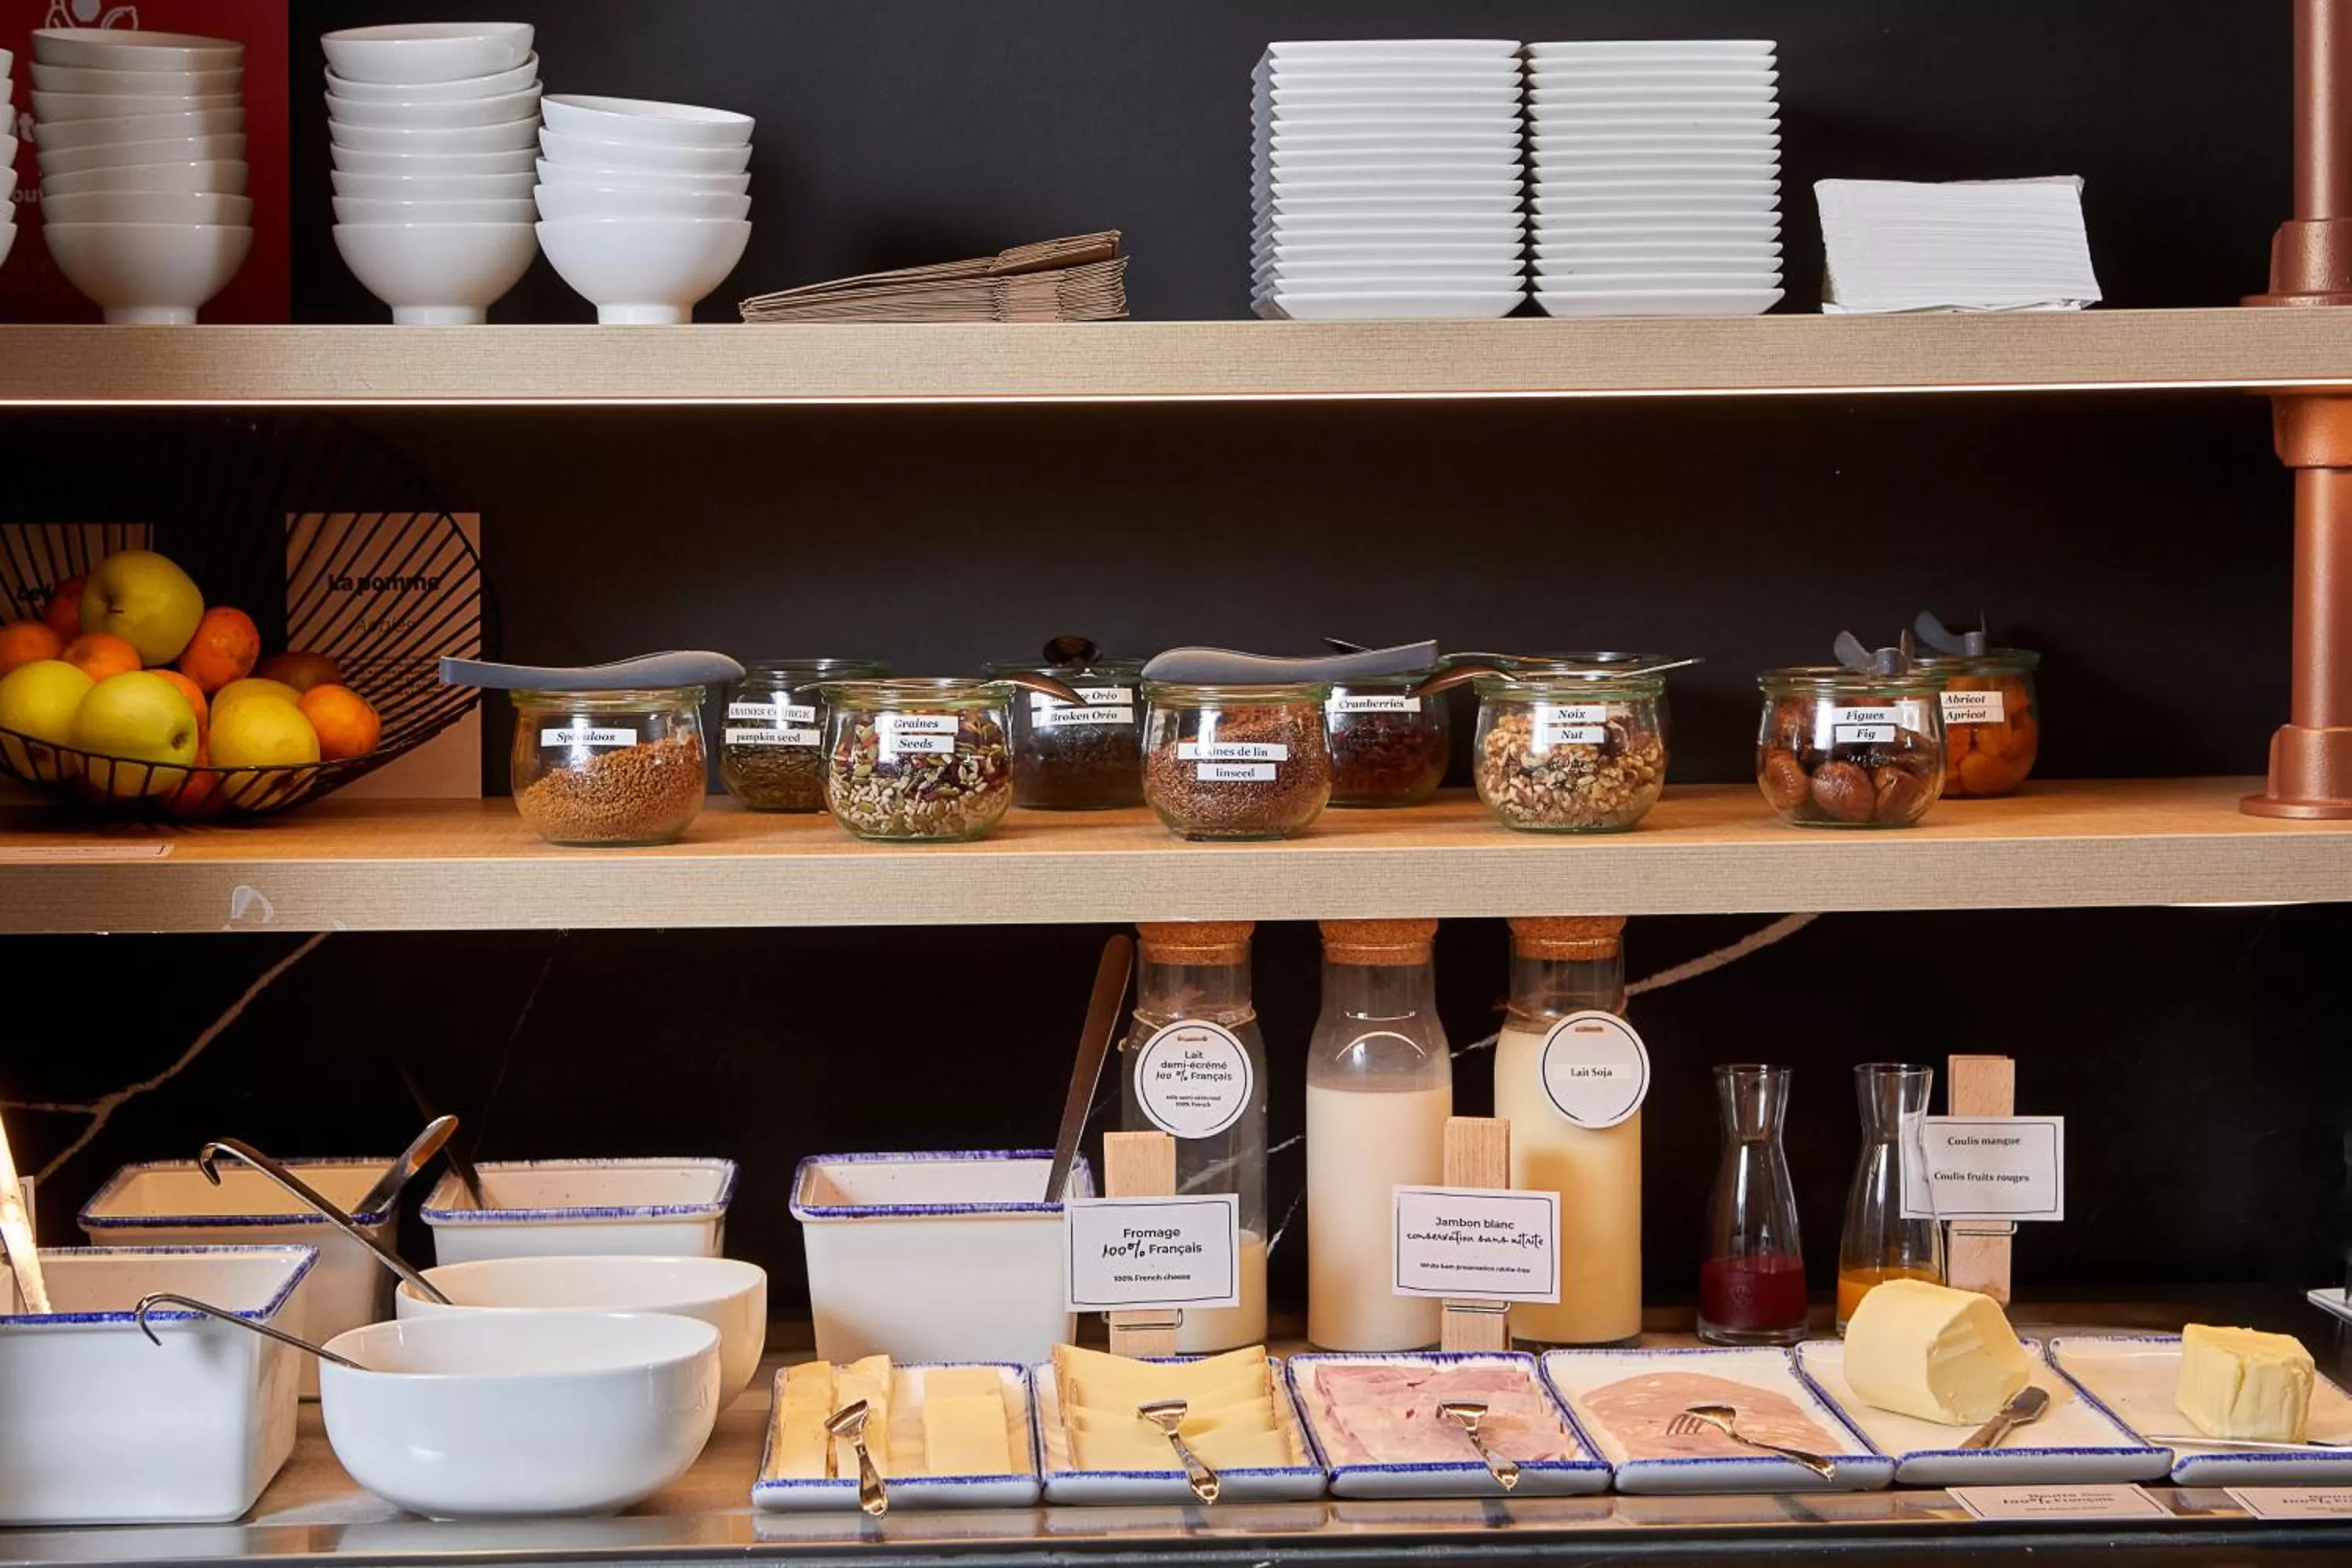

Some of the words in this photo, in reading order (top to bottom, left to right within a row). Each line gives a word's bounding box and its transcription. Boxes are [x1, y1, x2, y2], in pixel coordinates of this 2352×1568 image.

[1338, 699, 1404, 709] Cranberries
[1945, 694, 1985, 703] Abricot
[1558, 709, 1586, 719] Noix
[1846, 710, 1885, 721] Figues
[1946, 709, 1986, 721] Apricot
[894, 718, 938, 728] Graines
[737, 732, 775, 744] pumpkin
[777, 734, 800, 742] seed
[1561, 730, 1583, 739] Nut
[1857, 729, 1876, 740] Fig
[898, 739, 933, 749] Seeds
[1237, 747, 1251, 757] de
[1254, 747, 1269, 757] lin
[1216, 768, 1255, 778] linseed
[1185, 1050, 1203, 1059] Lait
[1190, 1071, 1233, 1082] Français
[1570, 1067, 1590, 1077] Lait
[1592, 1067, 1613, 1078] Soja
[1947, 1136, 1980, 1145] Coulis
[1981, 1138, 2020, 1146] mangue
[1934, 1172, 1965, 1181] Coulis
[1967, 1172, 1994, 1181] fruits
[1996, 1174, 2030, 1184] rouges
[1436, 1217, 1481, 1228] Jambon
[1484, 1219, 1515, 1230] blanc
[1123, 1228, 1181, 1239] Fromage
[1406, 1231, 1474, 1245] conservation
[1511, 1232, 1544, 1249] nitrite
[1102, 1240, 1145, 1258] 100%
[1149, 1242, 1202, 1254] Français
